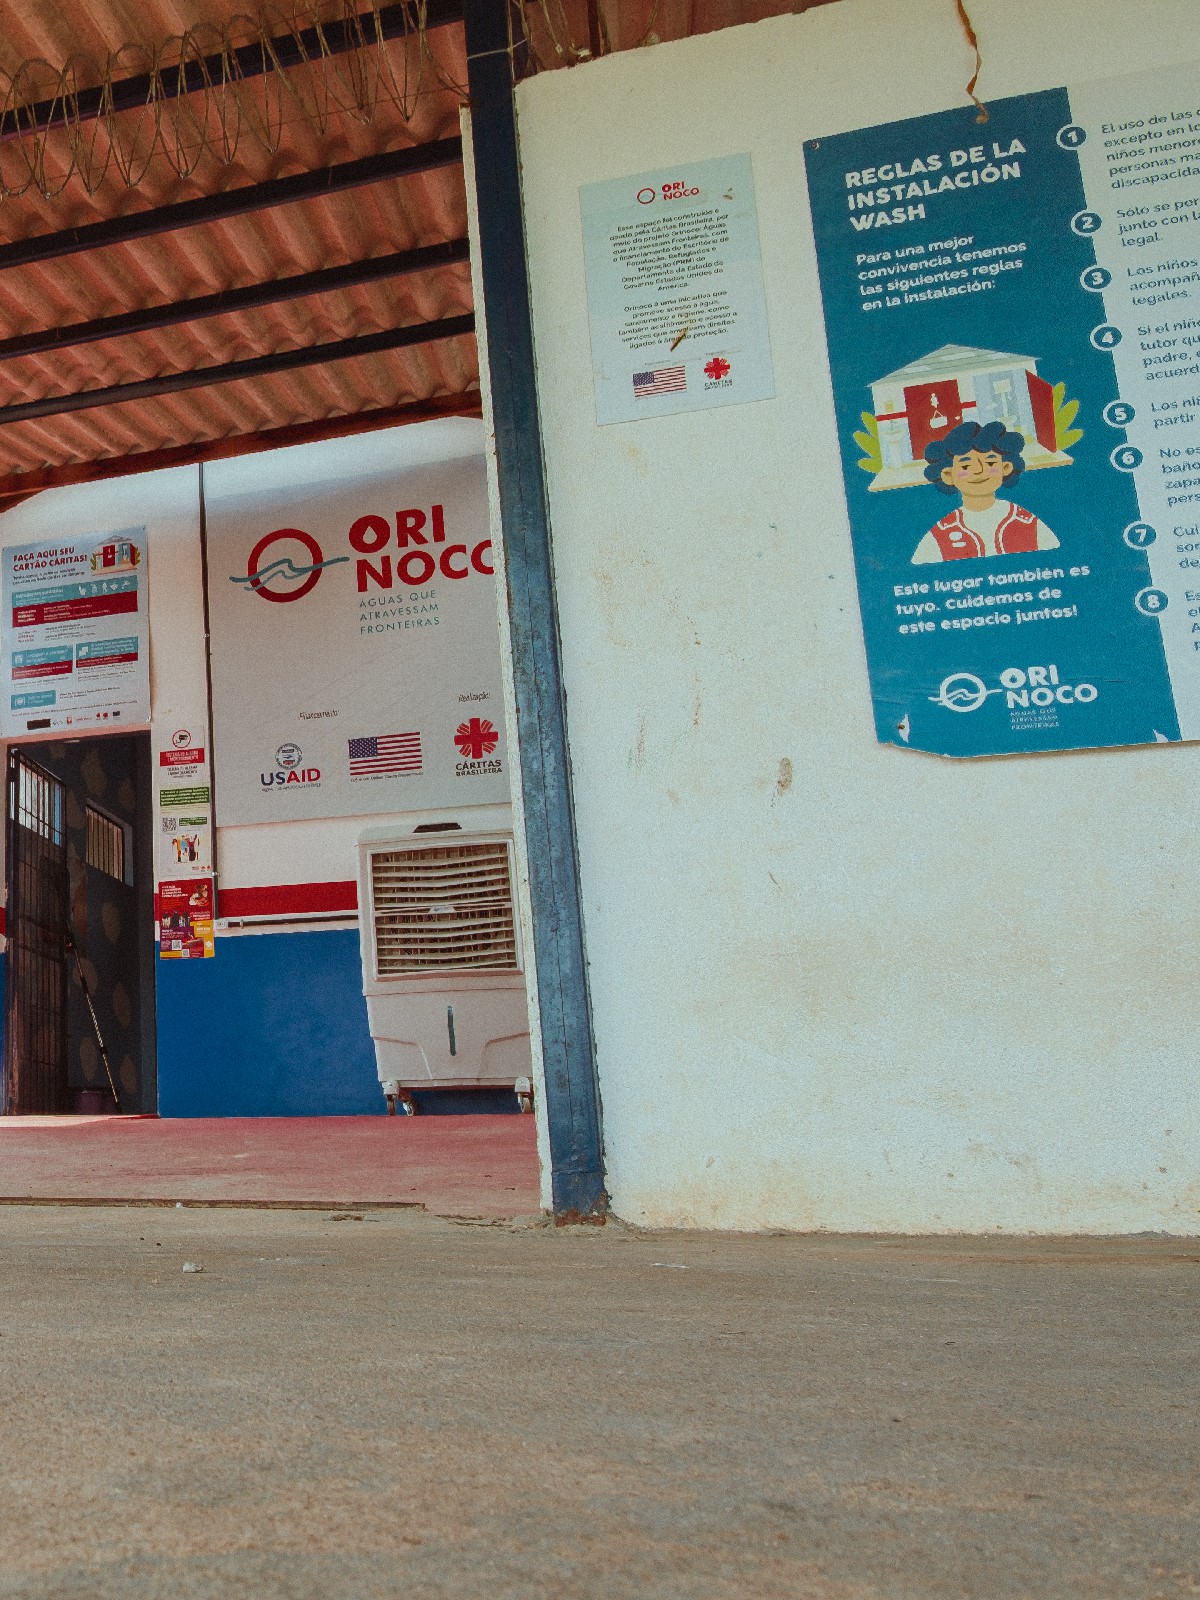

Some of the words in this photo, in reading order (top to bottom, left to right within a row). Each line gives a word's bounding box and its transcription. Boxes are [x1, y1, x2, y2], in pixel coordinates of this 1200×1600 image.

[1102, 124, 1115, 134] El
[1120, 120, 1144, 131] uso
[1148, 115, 1167, 125] de
[1171, 111, 1192, 121] las
[1104, 131, 1162, 148] excepto
[1167, 127, 1184, 136] en
[845, 155, 942, 189] REGLAS
[950, 146, 986, 168] DE
[992, 138, 1027, 159] LA
[1107, 148, 1145, 161] niños
[1109, 158, 1176, 177] personas
[662, 181, 685, 193] ORI
[848, 162, 1021, 211] INSTALACIÓN
[1112, 167, 1200, 189] discapacida
[663, 187, 700, 201] NOCO
[849, 203, 926, 232] WASH
[1117, 206, 1149, 218] Sólo
[1154, 204, 1170, 213] se
[1118, 219, 1158, 235] junto
[1162, 215, 1189, 226] con
[1122, 232, 1163, 247] legal.
[856, 251, 891, 266] Para
[895, 243, 925, 258] una
[928, 236, 974, 252] mejor
[858, 255, 952, 280] convivencia
[955, 242, 1027, 263] tenemos
[1127, 266, 1154, 277] Los
[1158, 259, 1198, 273] niños
[860, 283, 883, 296] las
[887, 268, 969, 291] siguientes
[972, 258, 1024, 276] reglas
[1130, 271, 1200, 292] acompañ
[862, 300, 882, 311] en
[886, 295, 901, 308] la
[904, 279, 996, 304] instalación:
[1132, 290, 1192, 306] legales.
[1138, 325, 1151, 336] Si
[1155, 323, 1170, 333] el
[1141, 338, 1178, 351] tutor
[1143, 352, 1192, 368] padre,
[1146, 364, 1200, 381] acuerd
[1115, 407, 1127, 421] 5
[1151, 401, 1179, 412] Los
[1154, 413, 1196, 429] partir
[1160, 448, 1181, 459] No
[349, 505, 445, 554] ORI
[13, 552, 35, 563] FAÇA
[37, 549, 58, 558] AQUI
[60, 547, 75, 555] SEU
[13, 560, 47, 572] CARTÃO
[49, 555, 87, 567] CÁRITAS!
[893, 582, 930, 597] Este
[934, 577, 983, 593] lugar
[988, 567, 1065, 586] también
[1069, 565, 1090, 578] es
[409, 590, 436, 602] QUE
[896, 602, 941, 617] tuyo.
[945, 591, 1034, 610] Cuidemos
[1038, 587, 1063, 600] de
[360, 603, 439, 622] ATRAVESSAM
[899, 620, 936, 634] este
[941, 612, 1011, 630] espacio
[1015, 604, 1078, 625] juntos!
[360, 617, 440, 635] FRONTEIRAS
[1000, 664, 1059, 689] ORI
[1006, 683, 1098, 709] NOCO
[455, 759, 502, 771] CÁRITAS
[455, 768, 503, 777] BRASILEIRA
[260, 768, 321, 787] USAID
